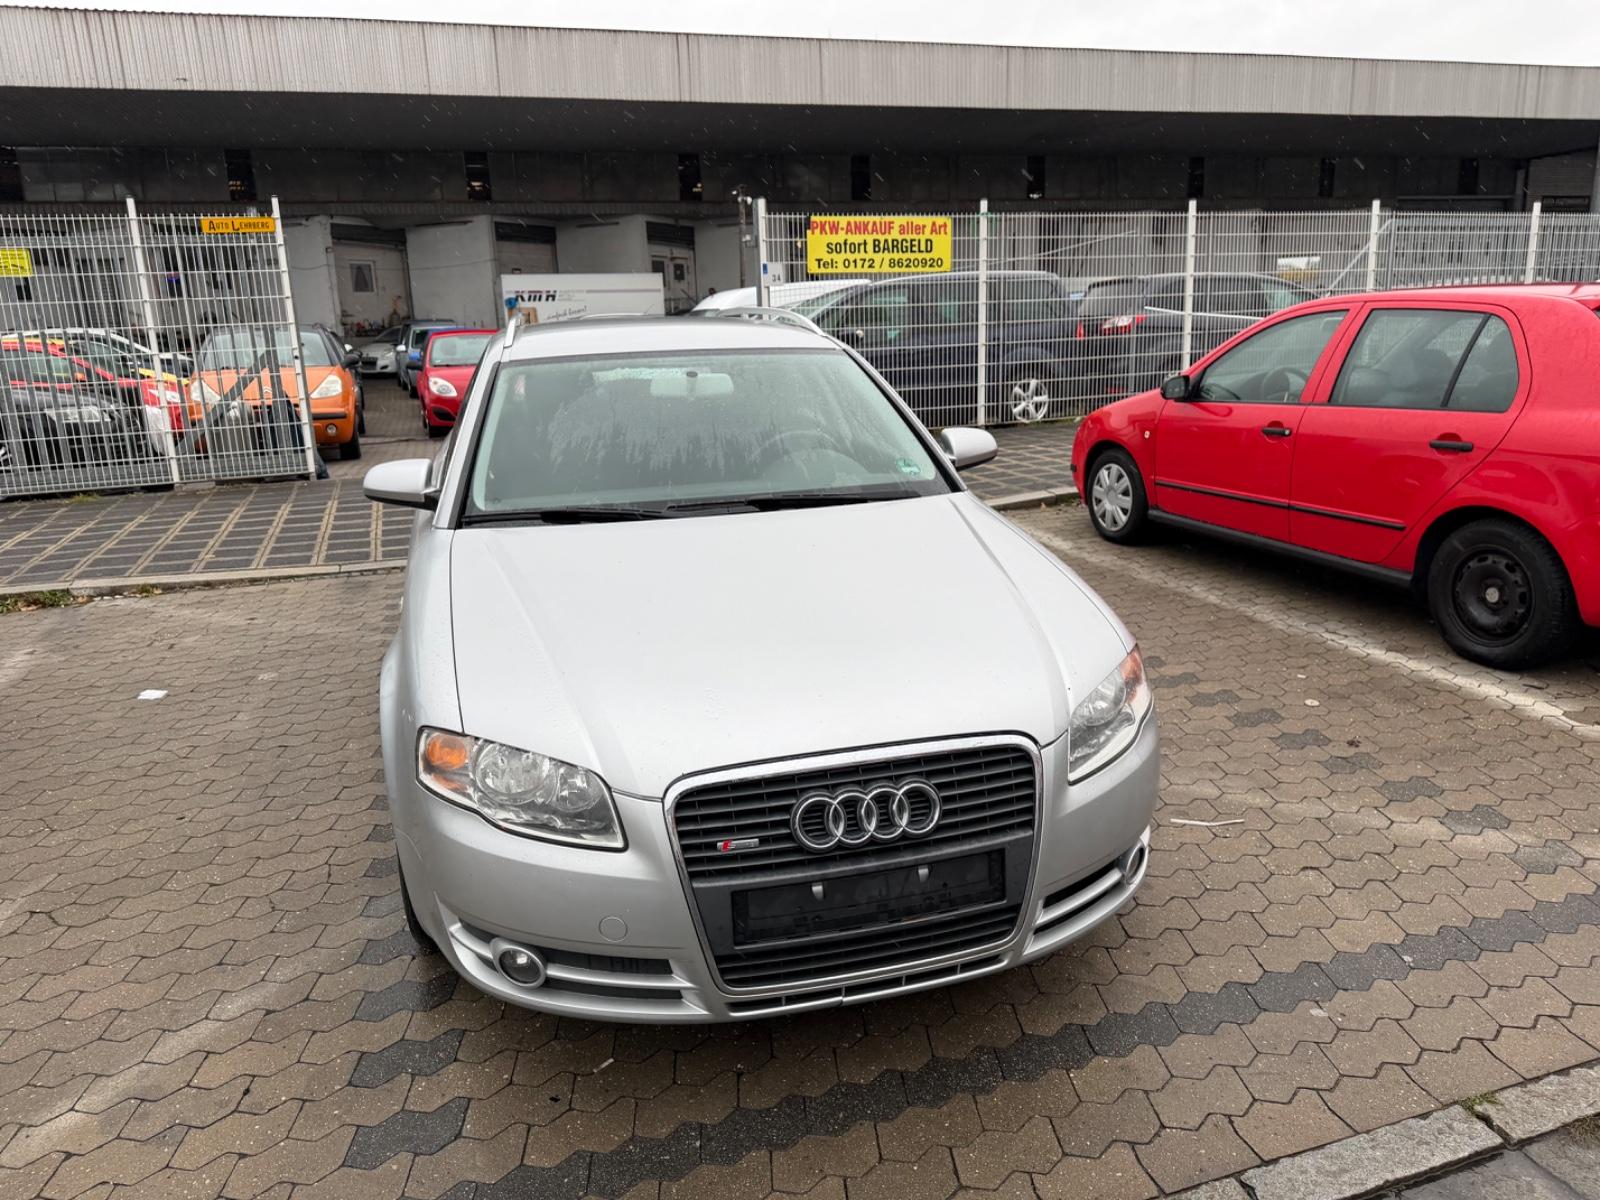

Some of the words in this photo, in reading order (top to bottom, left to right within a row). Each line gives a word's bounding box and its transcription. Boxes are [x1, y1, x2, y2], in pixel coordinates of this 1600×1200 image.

[810, 220, 894, 235] PKW-ANKAUF
[898, 221, 926, 235] aller
[930, 221, 948, 235] Art
[826, 238, 868, 254] sofort
[873, 238, 933, 254] BARGELD
[815, 258, 838, 269] Tel:
[843, 258, 875, 269] 0172
[879, 257, 885, 269] /
[888, 257, 943, 269] 8620920
